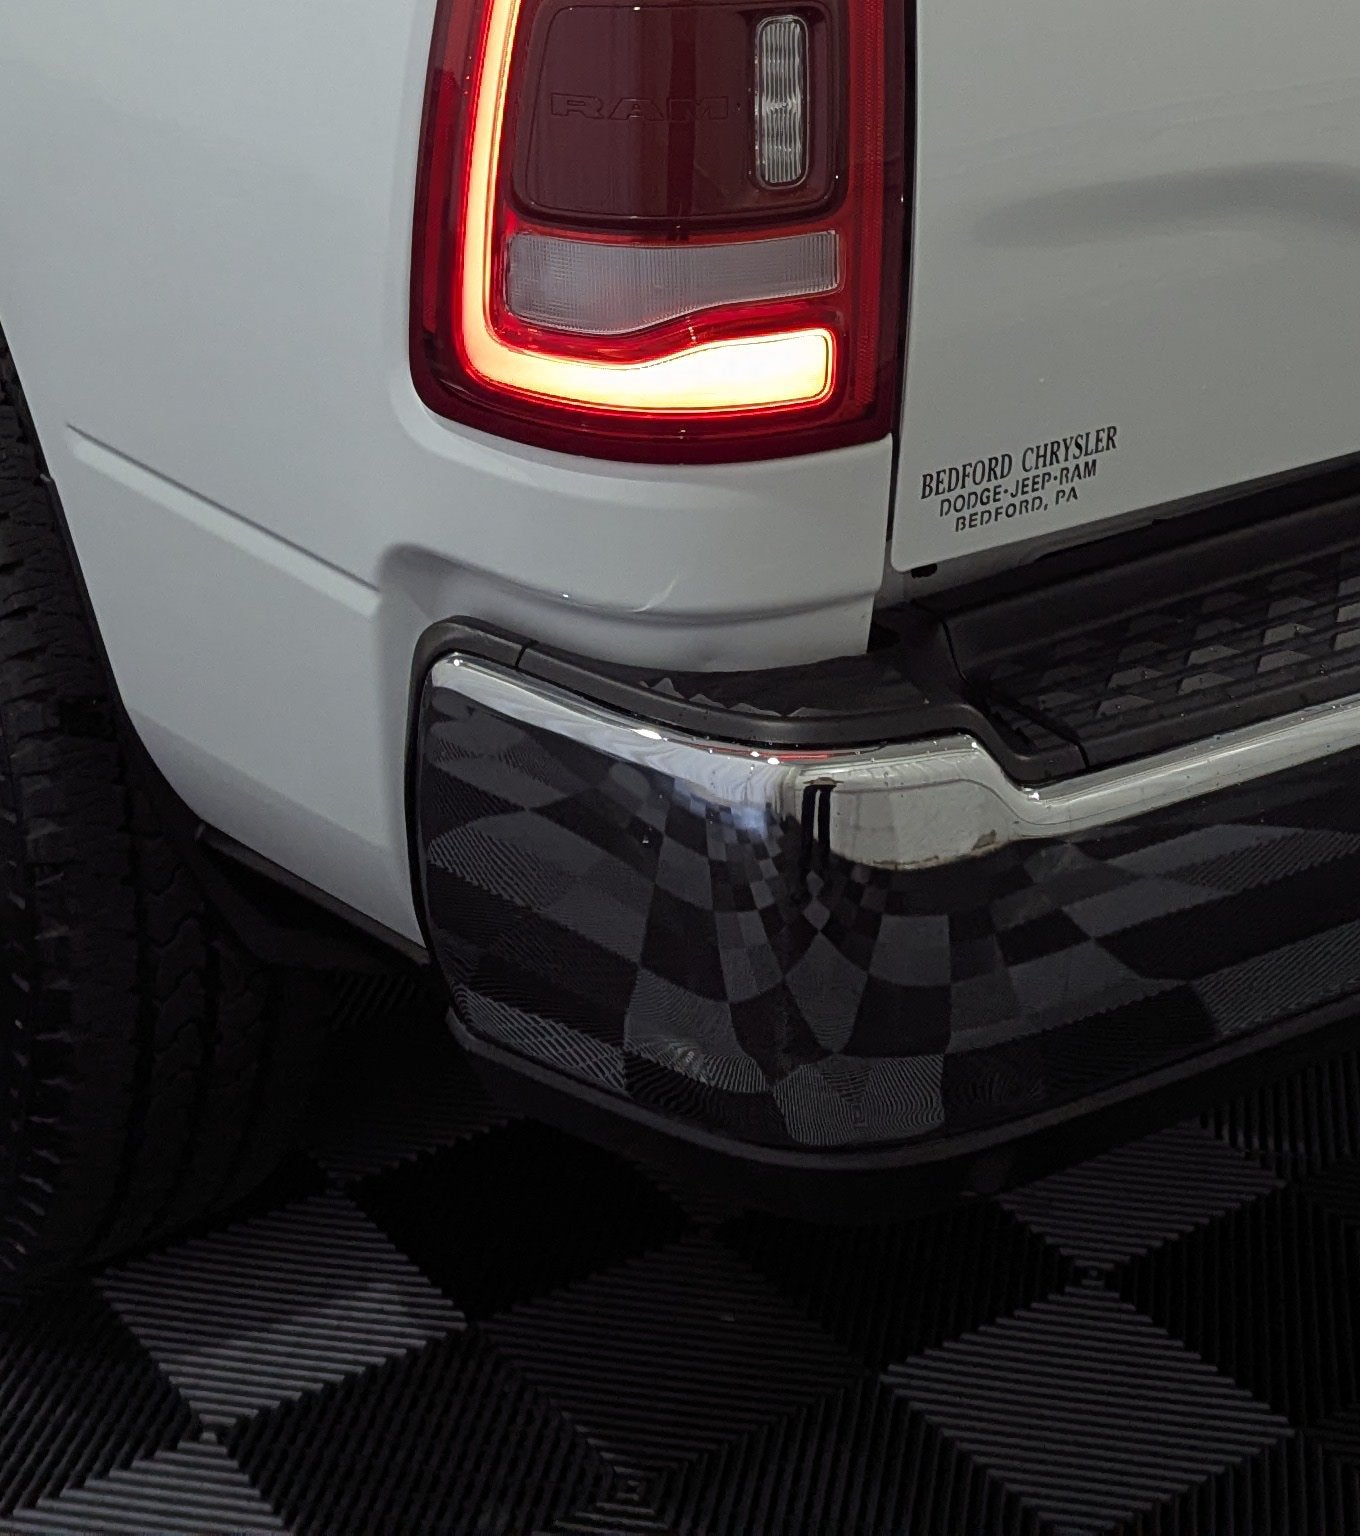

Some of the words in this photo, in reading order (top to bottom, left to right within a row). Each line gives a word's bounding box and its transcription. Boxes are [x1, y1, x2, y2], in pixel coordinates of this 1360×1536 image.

[550, 92, 730, 122] RAM
[920, 452, 1013, 500] BEDFORD
[1021, 425, 1118, 473] CHRYSLER
[954, 495, 1050, 533] BEDFORD,
[1054, 486, 1079, 505] PA
